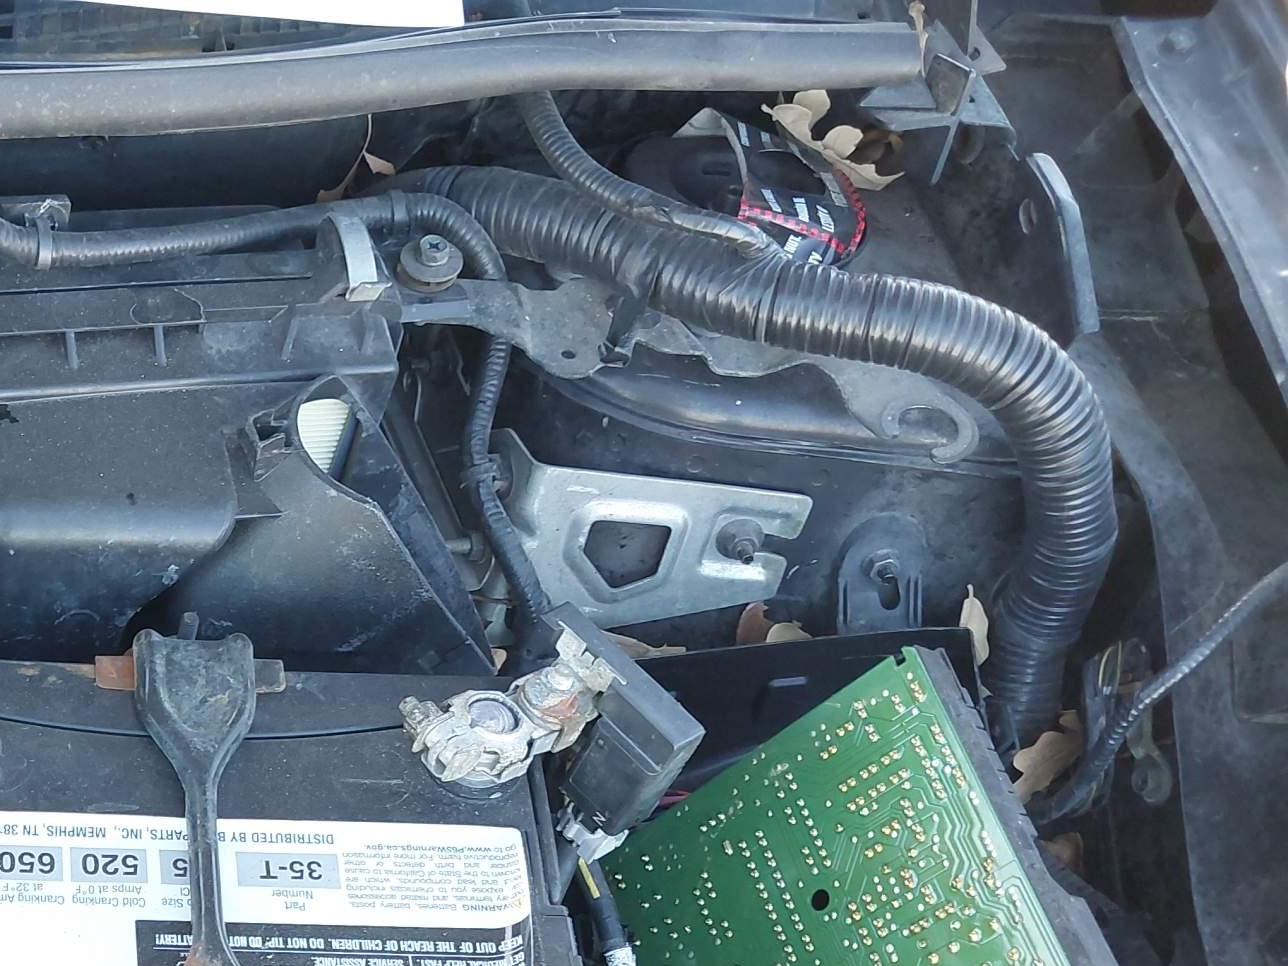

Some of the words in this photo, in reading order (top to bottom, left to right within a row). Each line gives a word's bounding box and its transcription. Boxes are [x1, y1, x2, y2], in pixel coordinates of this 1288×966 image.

[22, 824, 39, 837] TN
[42, 823, 107, 839] MEMPHIS,
[230, 831, 246, 843] BY
[251, 832, 334, 845] DISTRIBUTED
[81, 853, 139, 876] 520
[172, 858, 188, 878] 5
[259, 860, 323, 881] 35-T
[32, 882, 44, 891] at
[97, 884, 109, 894] at
[112, 883, 142, 895] Amps
[179, 887, 191, 896] CI
[17, 892, 65, 905] Cranking
[71, 894, 119, 907] Cranking
[272, 889, 314, 900] Number
[122, 897, 146, 908] Cold
[161, 897, 184, 908] Size
[284, 901, 306, 912] Part
[155, 934, 193, 946] ATTERY!
[228, 936, 247, 947] NOT
[247, 936, 262, 947] DO
[287, 937, 307, 948] NOT
[309, 938, 324, 949] DO
[328, 938, 383, 951] CHILDREN.
[383, 940, 398, 951] OF
[400, 940, 434, 952] REACH
[498, 934, 523, 953] KEEP
[434, 941, 456, 953] THE
[458, 942, 473, 953] OF
[474, 942, 496, 953] OUT
